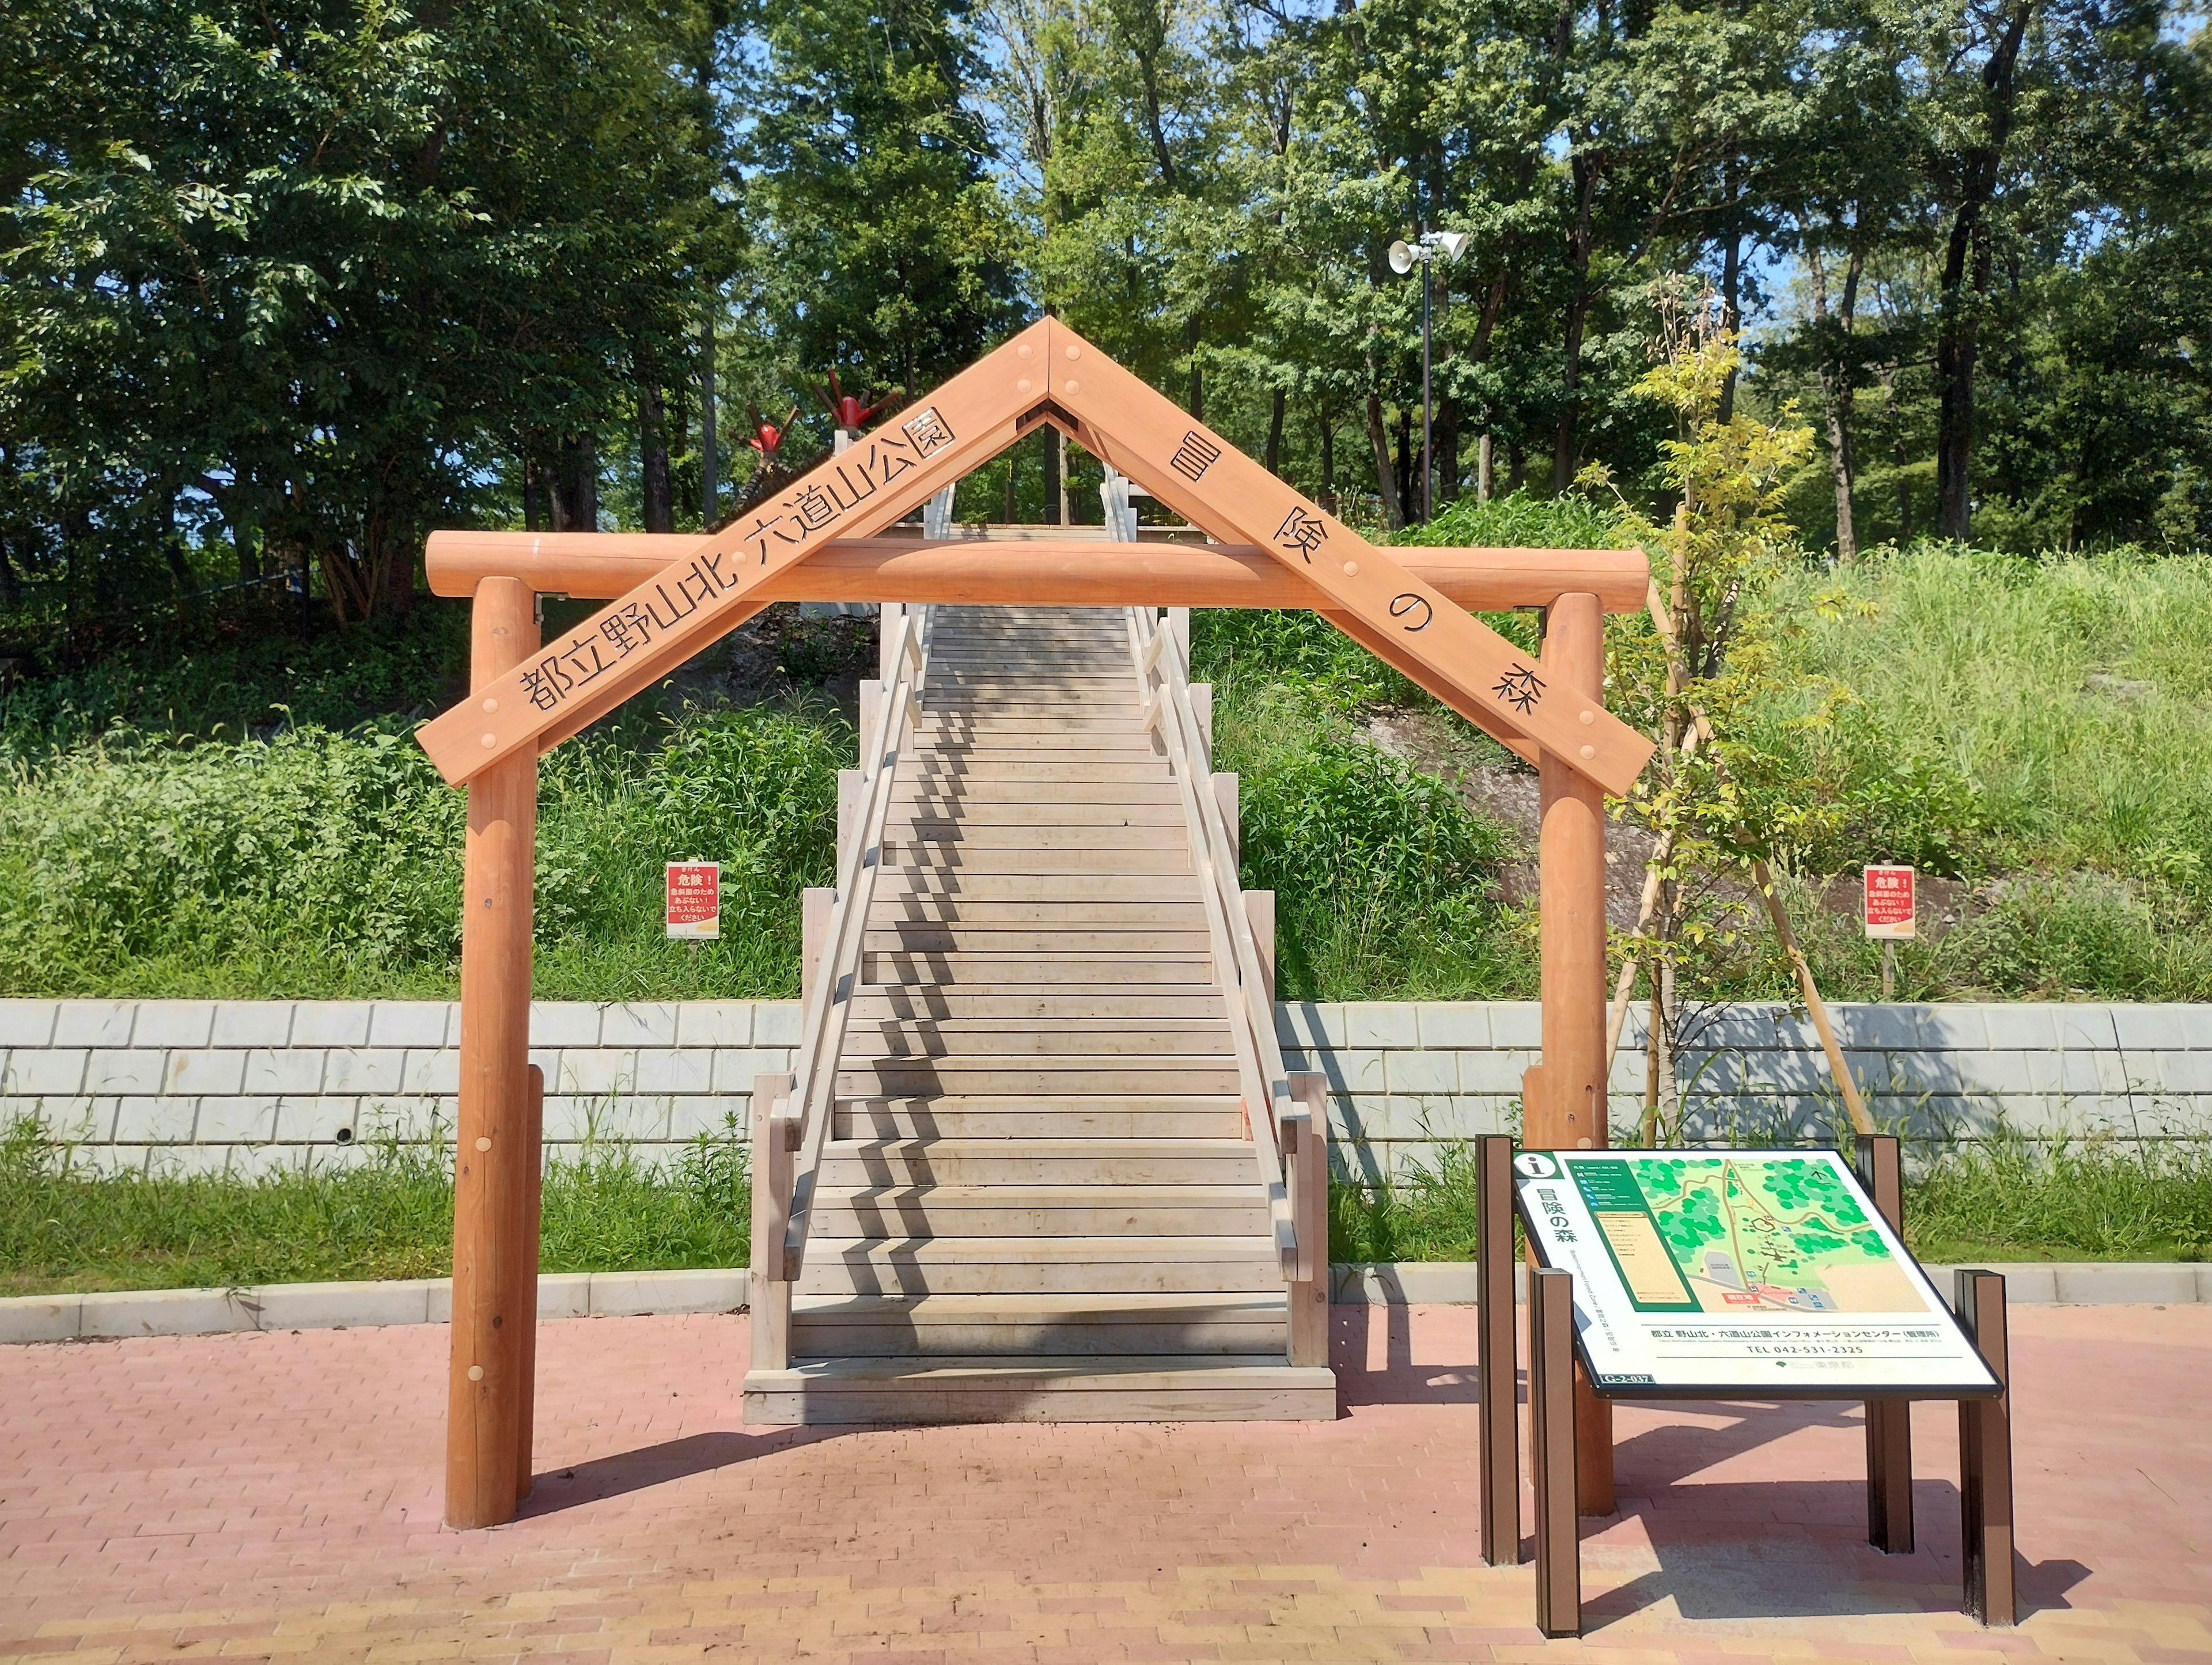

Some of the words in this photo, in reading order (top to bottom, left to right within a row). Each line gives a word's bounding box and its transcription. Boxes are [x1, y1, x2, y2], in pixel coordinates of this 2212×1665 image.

[1169, 430, 1548, 717] 冒険の森
[677, 874, 712, 886] 危険！
[1536, 1189, 1578, 1243] 冒険の森
[1605, 1375, 1649, 1383] G-2-037
